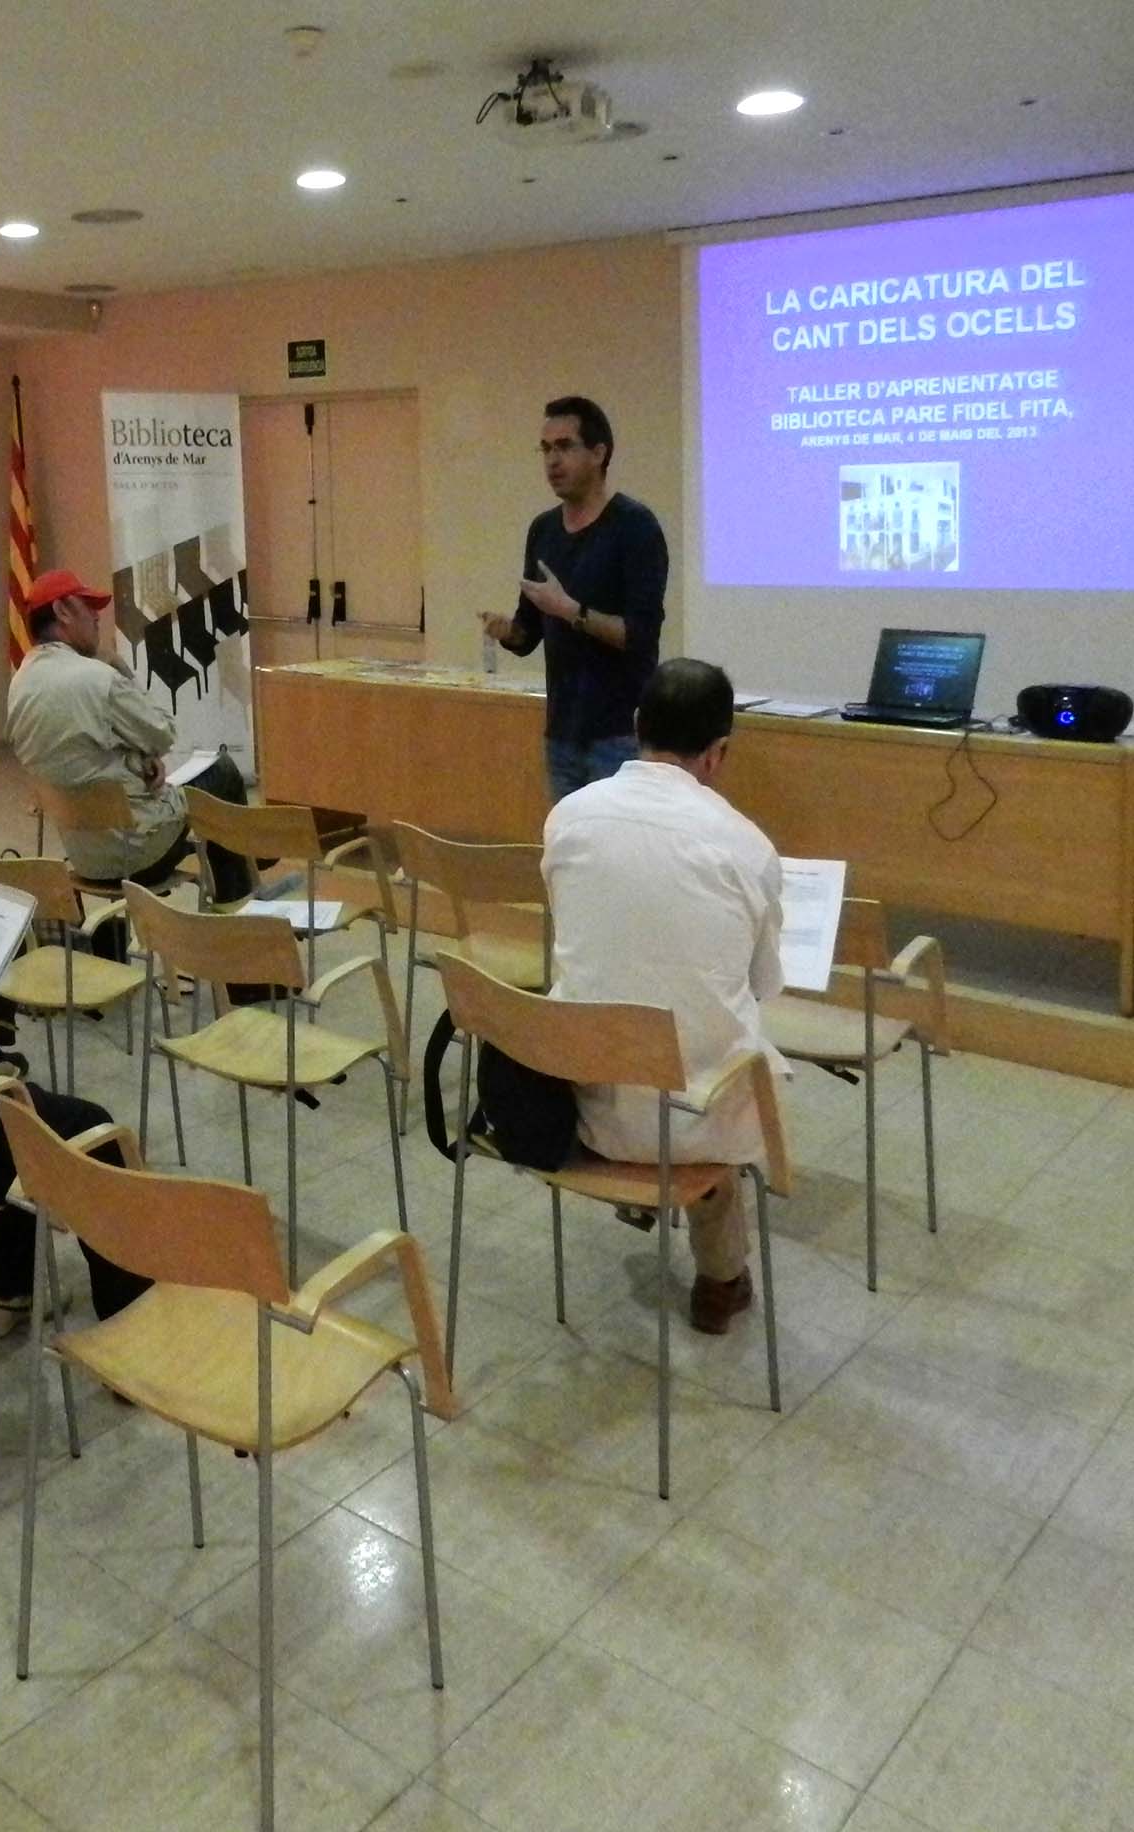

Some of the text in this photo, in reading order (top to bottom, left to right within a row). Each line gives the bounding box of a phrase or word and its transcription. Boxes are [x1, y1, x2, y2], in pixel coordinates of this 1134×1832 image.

[766, 259, 1085, 316] LA CARICATURA DEL
[772, 300, 1076, 352] CANT DELS OCELLS
[786, 368, 1059, 404] TALLER D'APRENENTATGE
[770, 397, 1075, 431] BIBLIOTECA PARE FIDEL FITA,
[111, 417, 233, 447] Biblioteca
[853, 432, 870, 446] DE
[918, 429, 937, 443] DE
[977, 426, 1003, 440] DEL
[113, 451, 207, 468] d'Arenys de Mar
